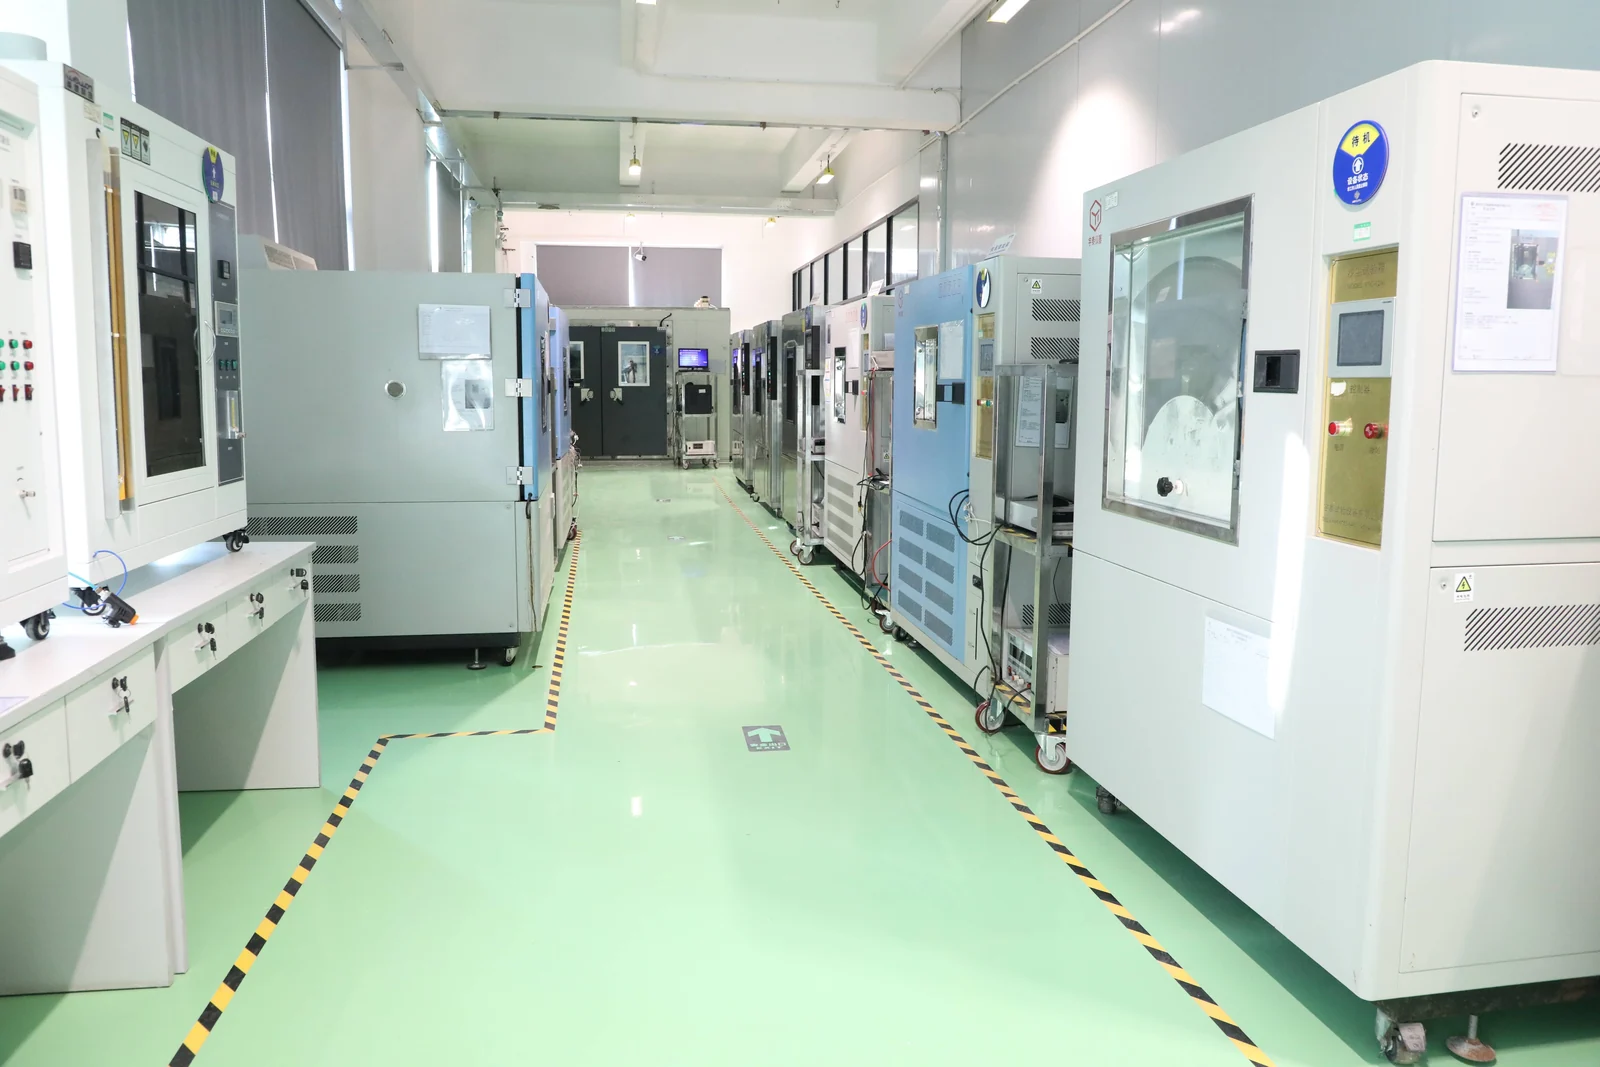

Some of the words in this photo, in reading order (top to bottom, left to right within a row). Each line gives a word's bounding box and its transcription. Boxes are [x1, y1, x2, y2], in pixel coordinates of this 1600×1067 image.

[1352, 132, 1371, 147] 待机
[1347, 173, 1368, 186] 设备状态
